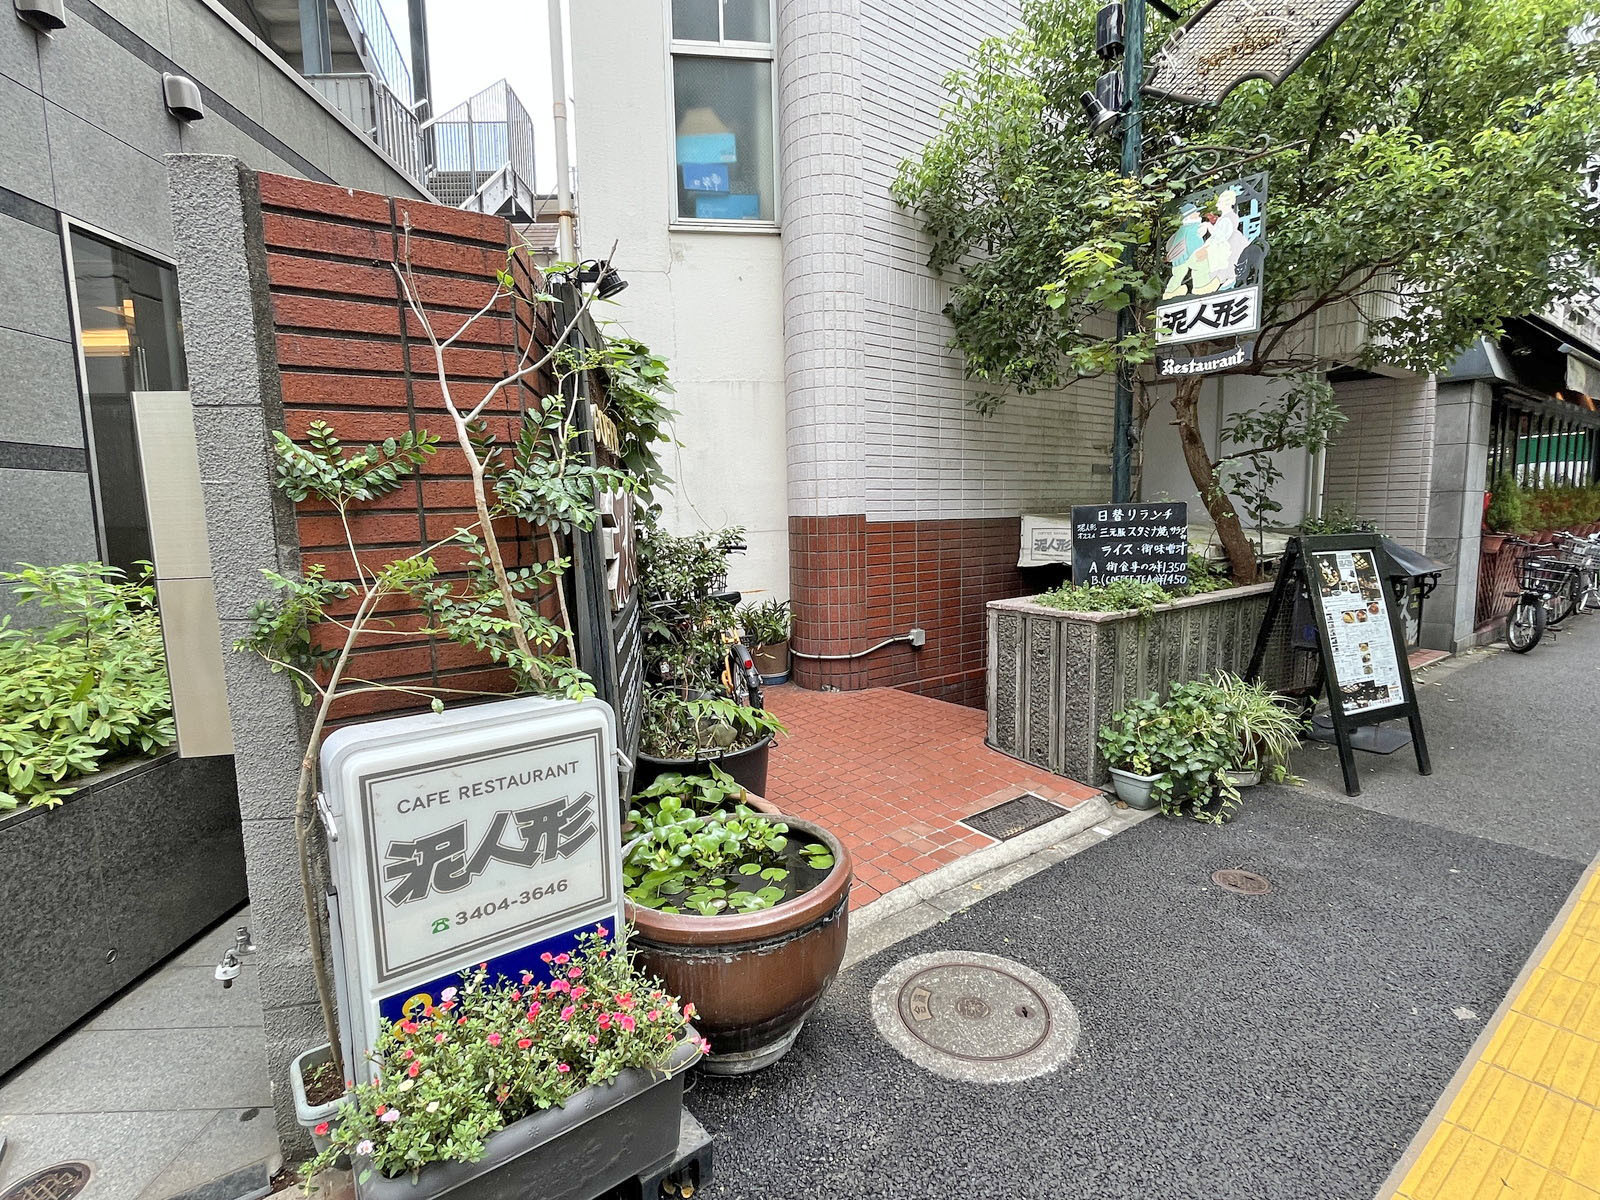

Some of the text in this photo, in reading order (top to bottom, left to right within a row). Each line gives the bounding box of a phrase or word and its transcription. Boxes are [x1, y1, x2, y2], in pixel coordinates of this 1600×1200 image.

[1162, 296, 1250, 336] 泥人形
[1161, 347, 1245, 376] Restaurant
[1034, 537, 1072, 552] 泥人形
[397, 760, 579, 814] CAFE RESTAURANT
[383, 791, 599, 909] 泥人形
[455, 879, 569, 926] 3404-3646
